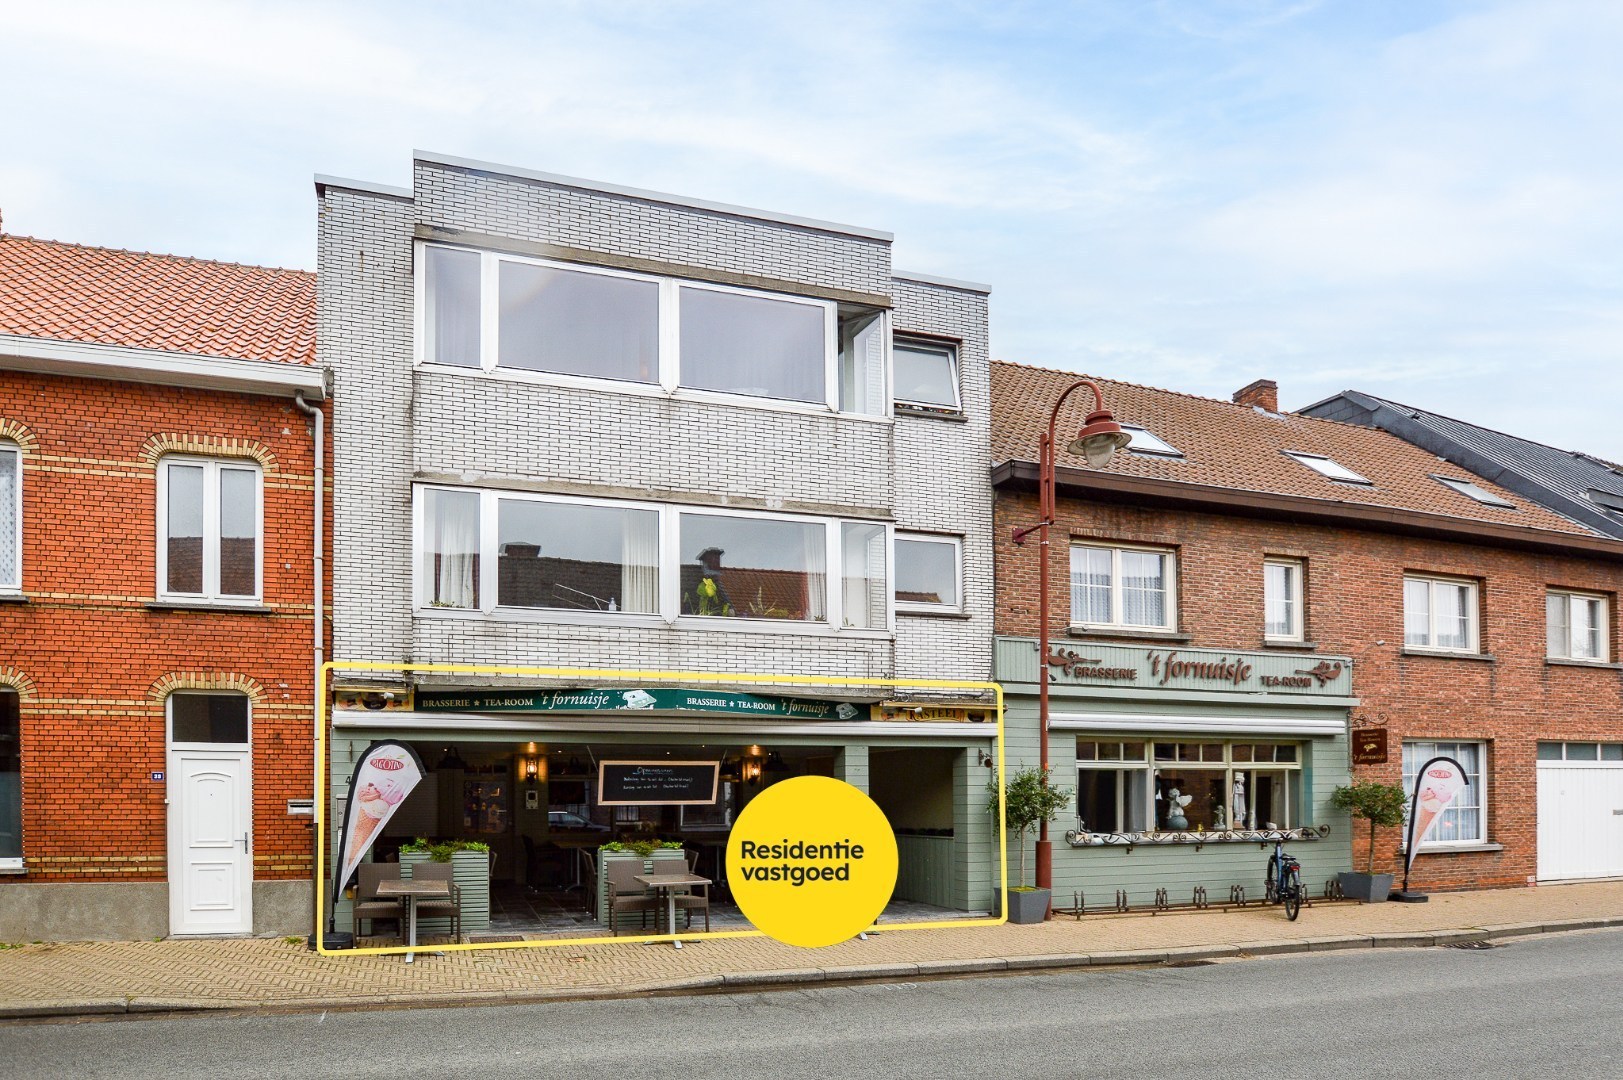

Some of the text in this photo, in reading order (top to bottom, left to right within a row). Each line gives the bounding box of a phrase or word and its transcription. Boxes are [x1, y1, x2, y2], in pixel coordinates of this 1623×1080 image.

[1074, 650, 1312, 688] BRASSERIE 't fornuisje TEA-ROOM
[422, 699, 471, 708] BRASSERIE
[484, 698, 534, 707] TEA-ROOM
[540, 691, 549, 705] 't
[549, 690, 610, 709] fornuisje
[686, 697, 830, 718] BRASSERIE TEA-ROOM 't fornuisje
